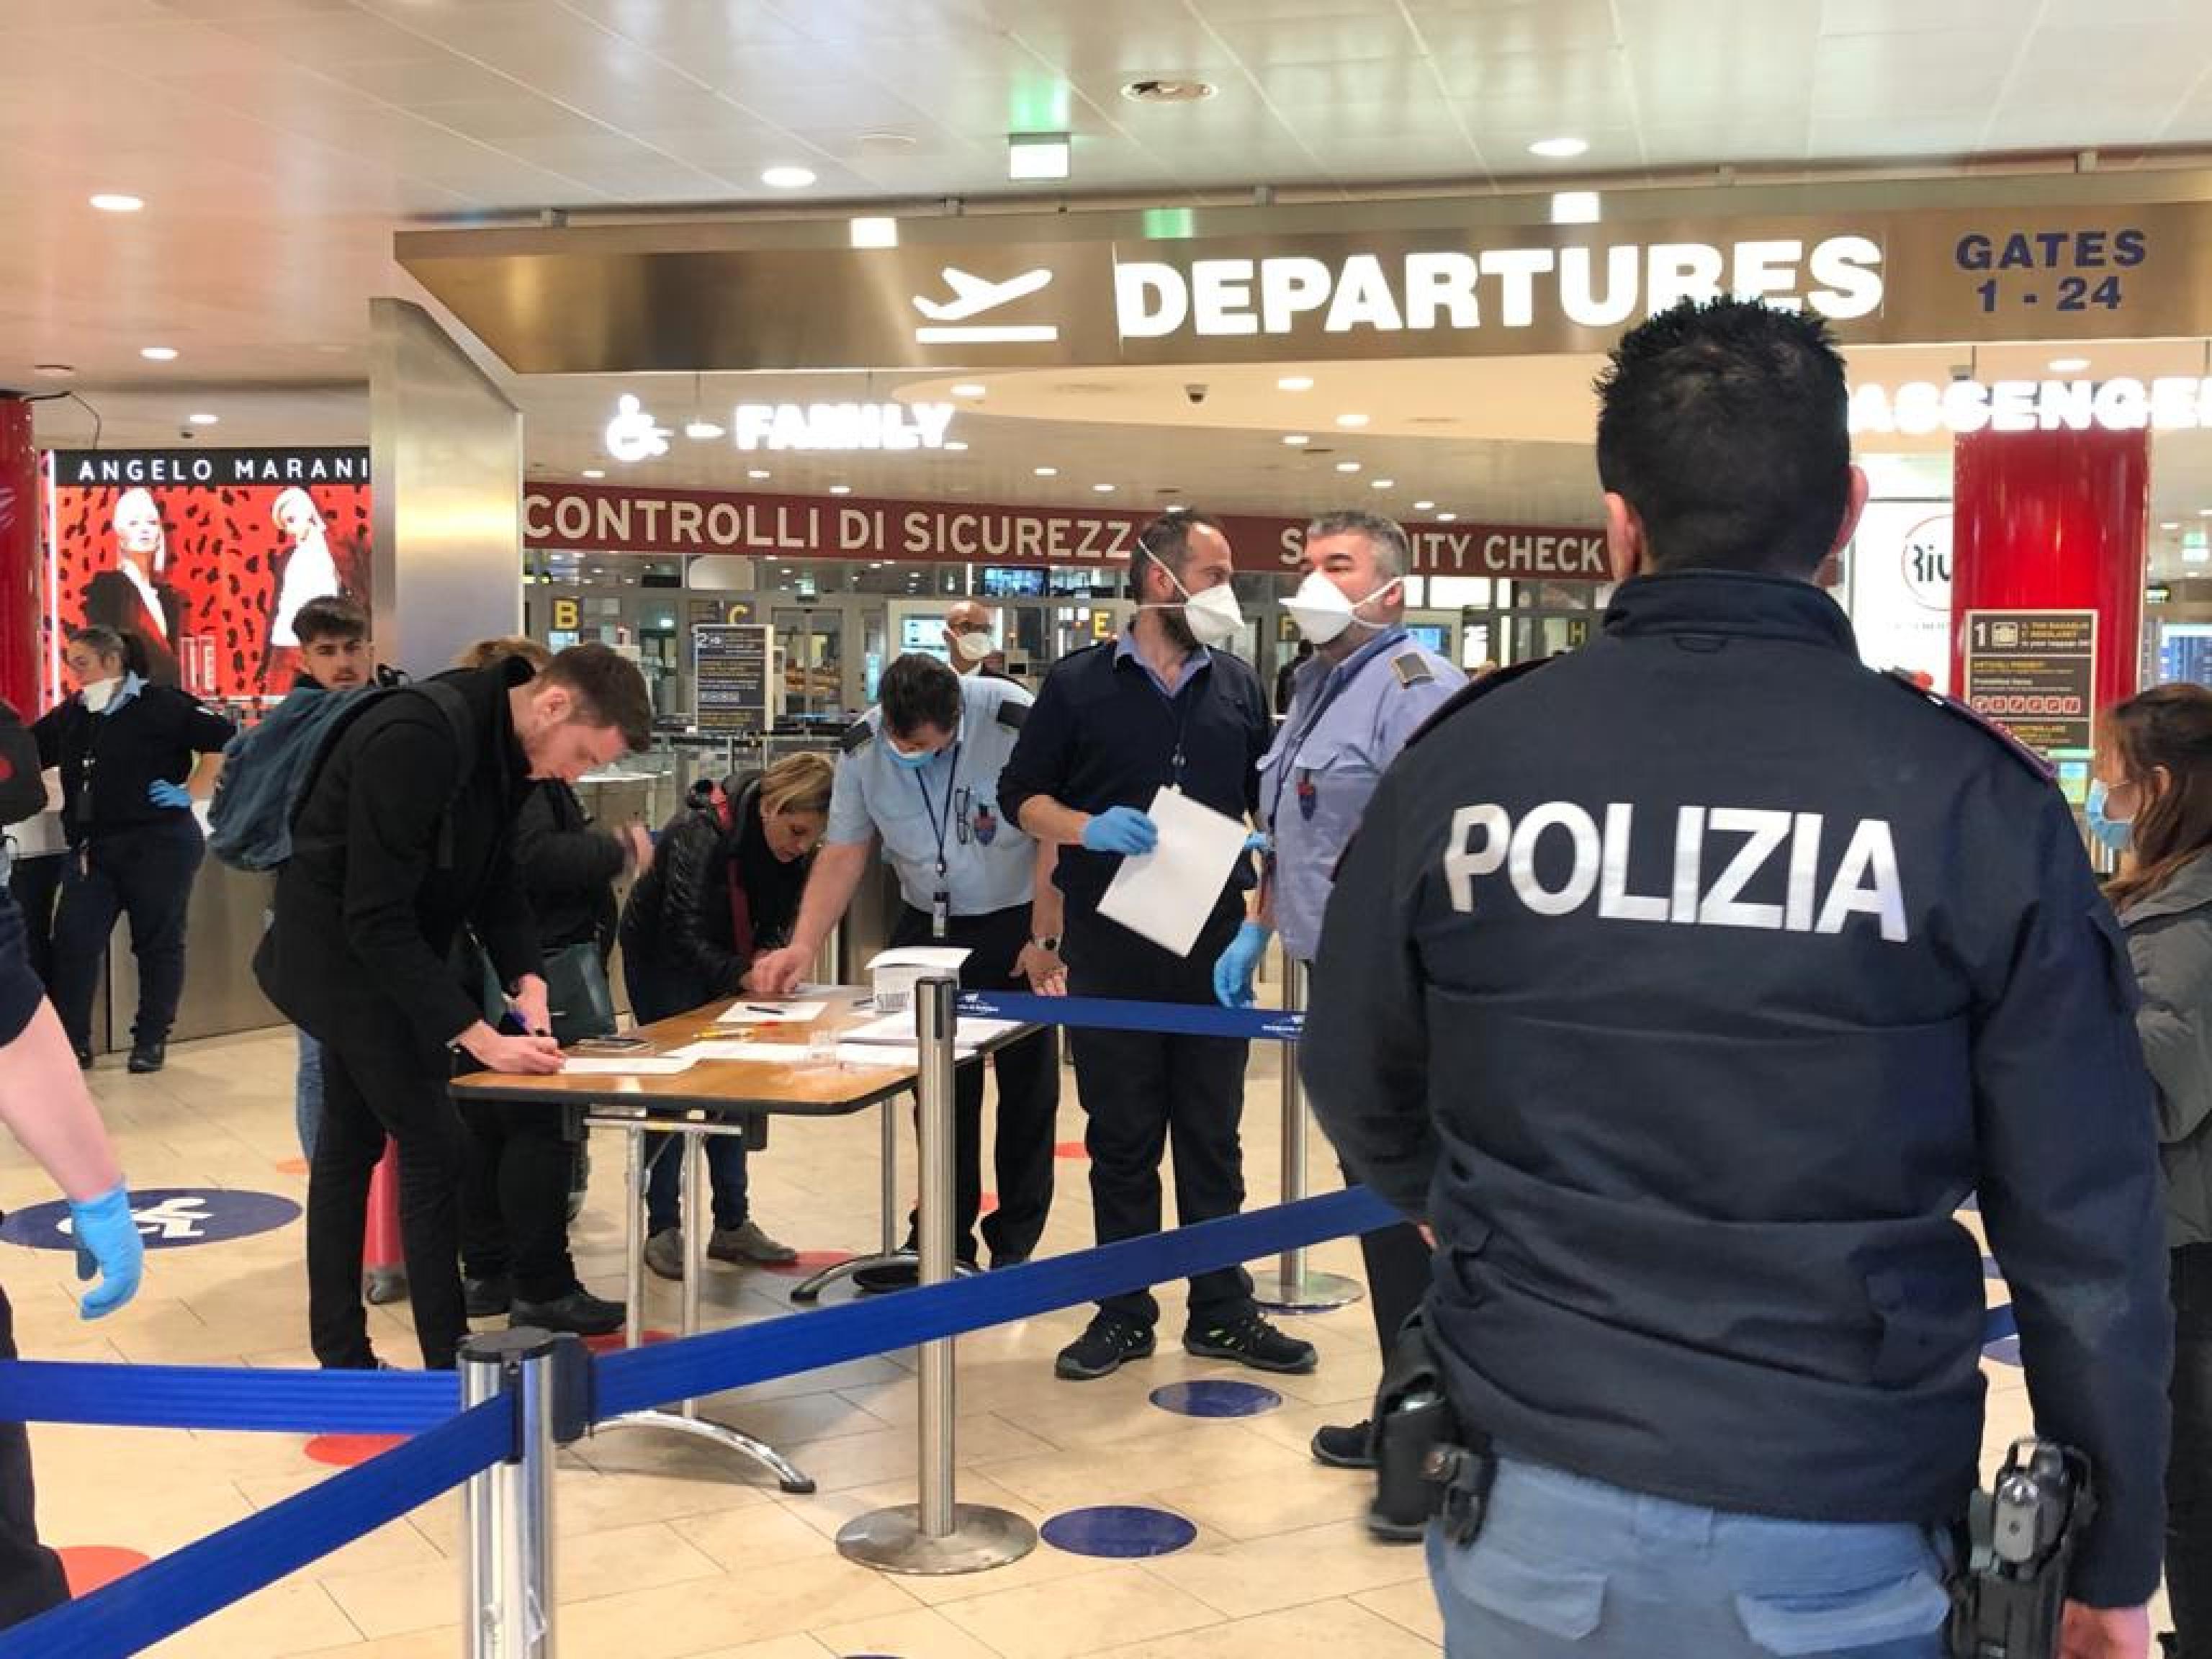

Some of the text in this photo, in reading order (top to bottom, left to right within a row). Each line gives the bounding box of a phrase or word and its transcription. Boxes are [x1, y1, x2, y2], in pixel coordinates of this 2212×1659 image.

[1956, 230, 2145, 269] GATES
[1117, 236, 1883, 337] DEPARTURES
[1977, 279, 1997, 312] 1
[2056, 276, 2122, 311] 24
[1848, 378, 2212, 433] ASSENGE
[736, 403, 956, 450] FAMILY
[79, 458, 369, 480] ANGELO MARANI
[525, 495, 1132, 558] CONTROLLI DI SICUREZZ
[1280, 527, 1604, 572] SITY CHECK
[555, 600, 577, 629] B
[1094, 611, 1110, 638] E
[1570, 621, 1586, 643] H
[1974, 624, 1986, 647] 1
[1444, 801, 1908, 943] POLIZIA
